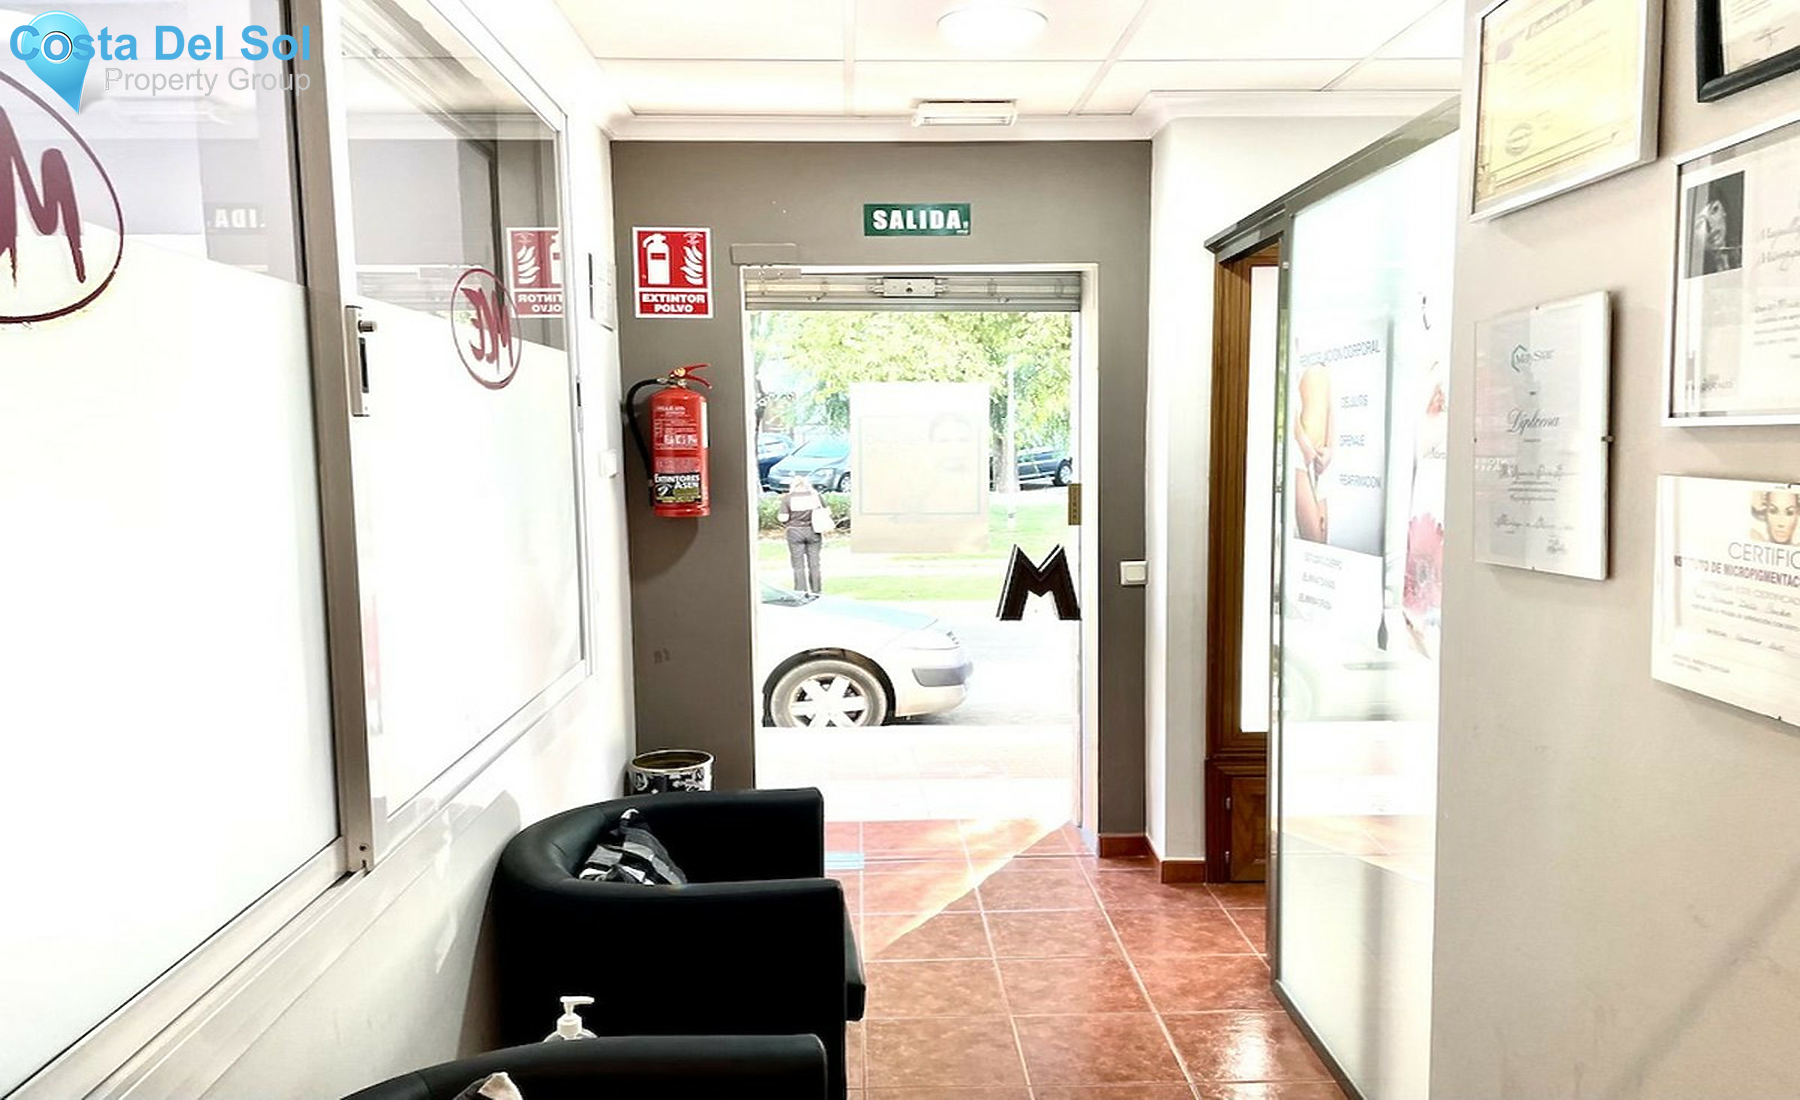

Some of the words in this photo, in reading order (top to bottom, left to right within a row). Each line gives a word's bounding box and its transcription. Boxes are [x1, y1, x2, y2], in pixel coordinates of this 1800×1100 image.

[642, 293, 705, 303] EXTINTOR
[654, 303, 693, 313] POLVO
[996, 544, 1082, 621] M
